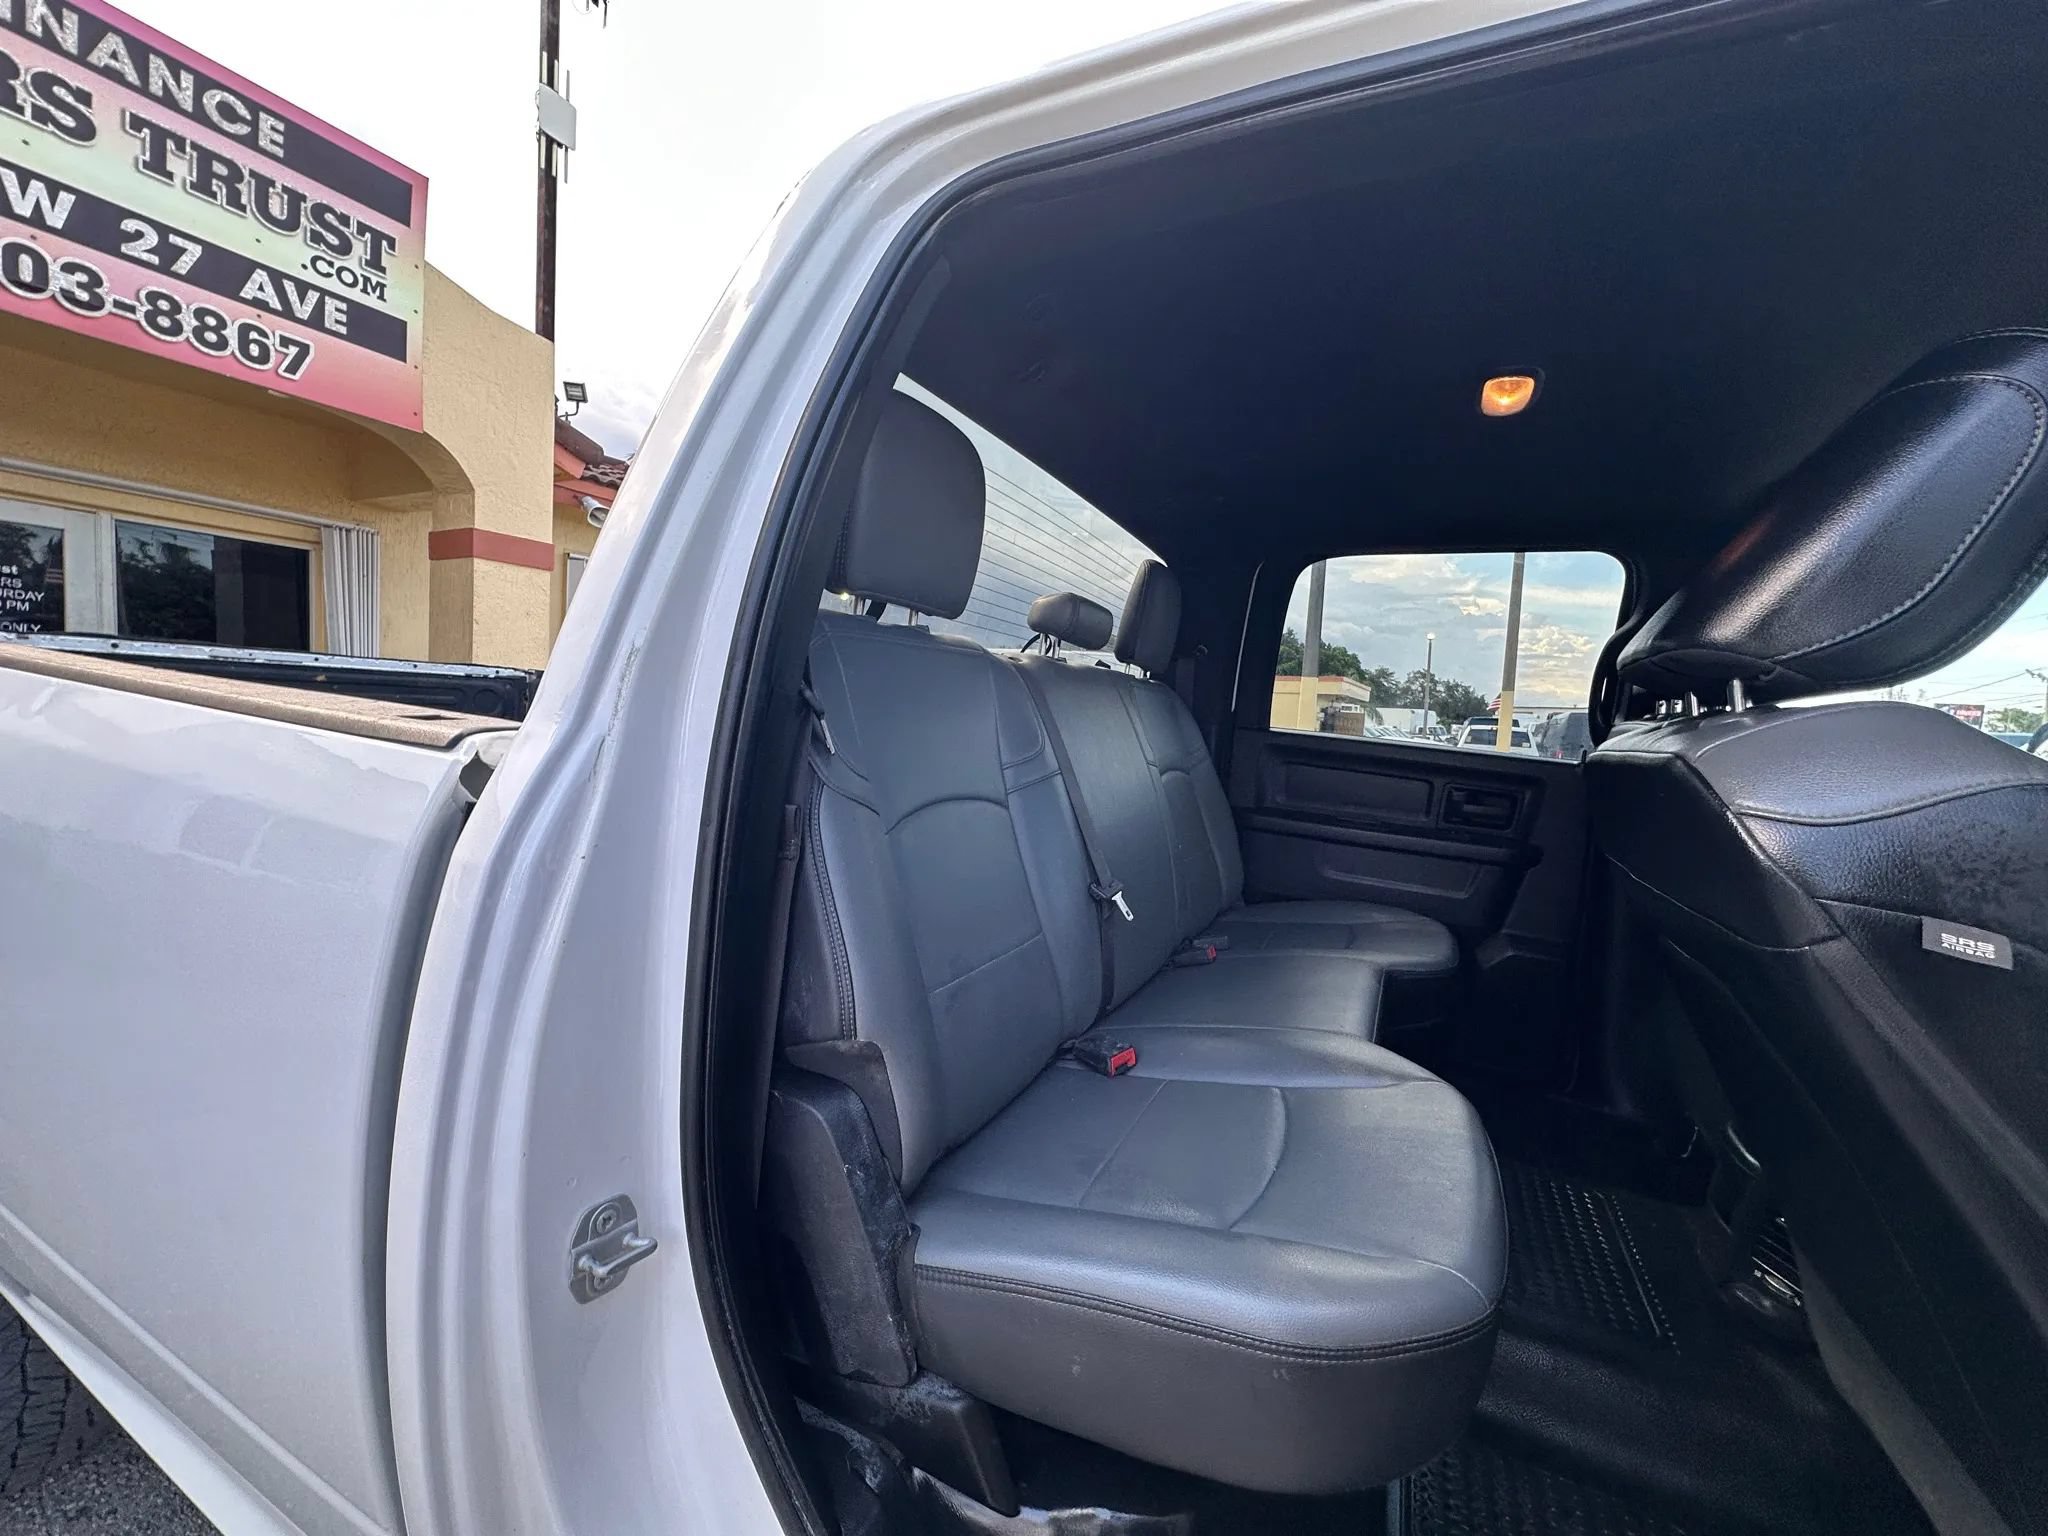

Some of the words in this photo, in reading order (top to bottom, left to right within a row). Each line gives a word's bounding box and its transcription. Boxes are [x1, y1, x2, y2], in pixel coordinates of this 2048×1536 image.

[0, 47, 98, 147] RS
[122, 107, 398, 279] TRUST
[0, 166, 76, 230] W
[120, 218, 202, 276] 27
[239, 268, 348, 335] AVE
[0, 237, 312, 379] 03-8867
[0, 564, 18, 575] st
[0, 588, 45, 601] RDAY
[6, 600, 29, 611] PM
[1941, 933, 1995, 951] SRS
[1941, 942, 1996, 959] AIRBAG
